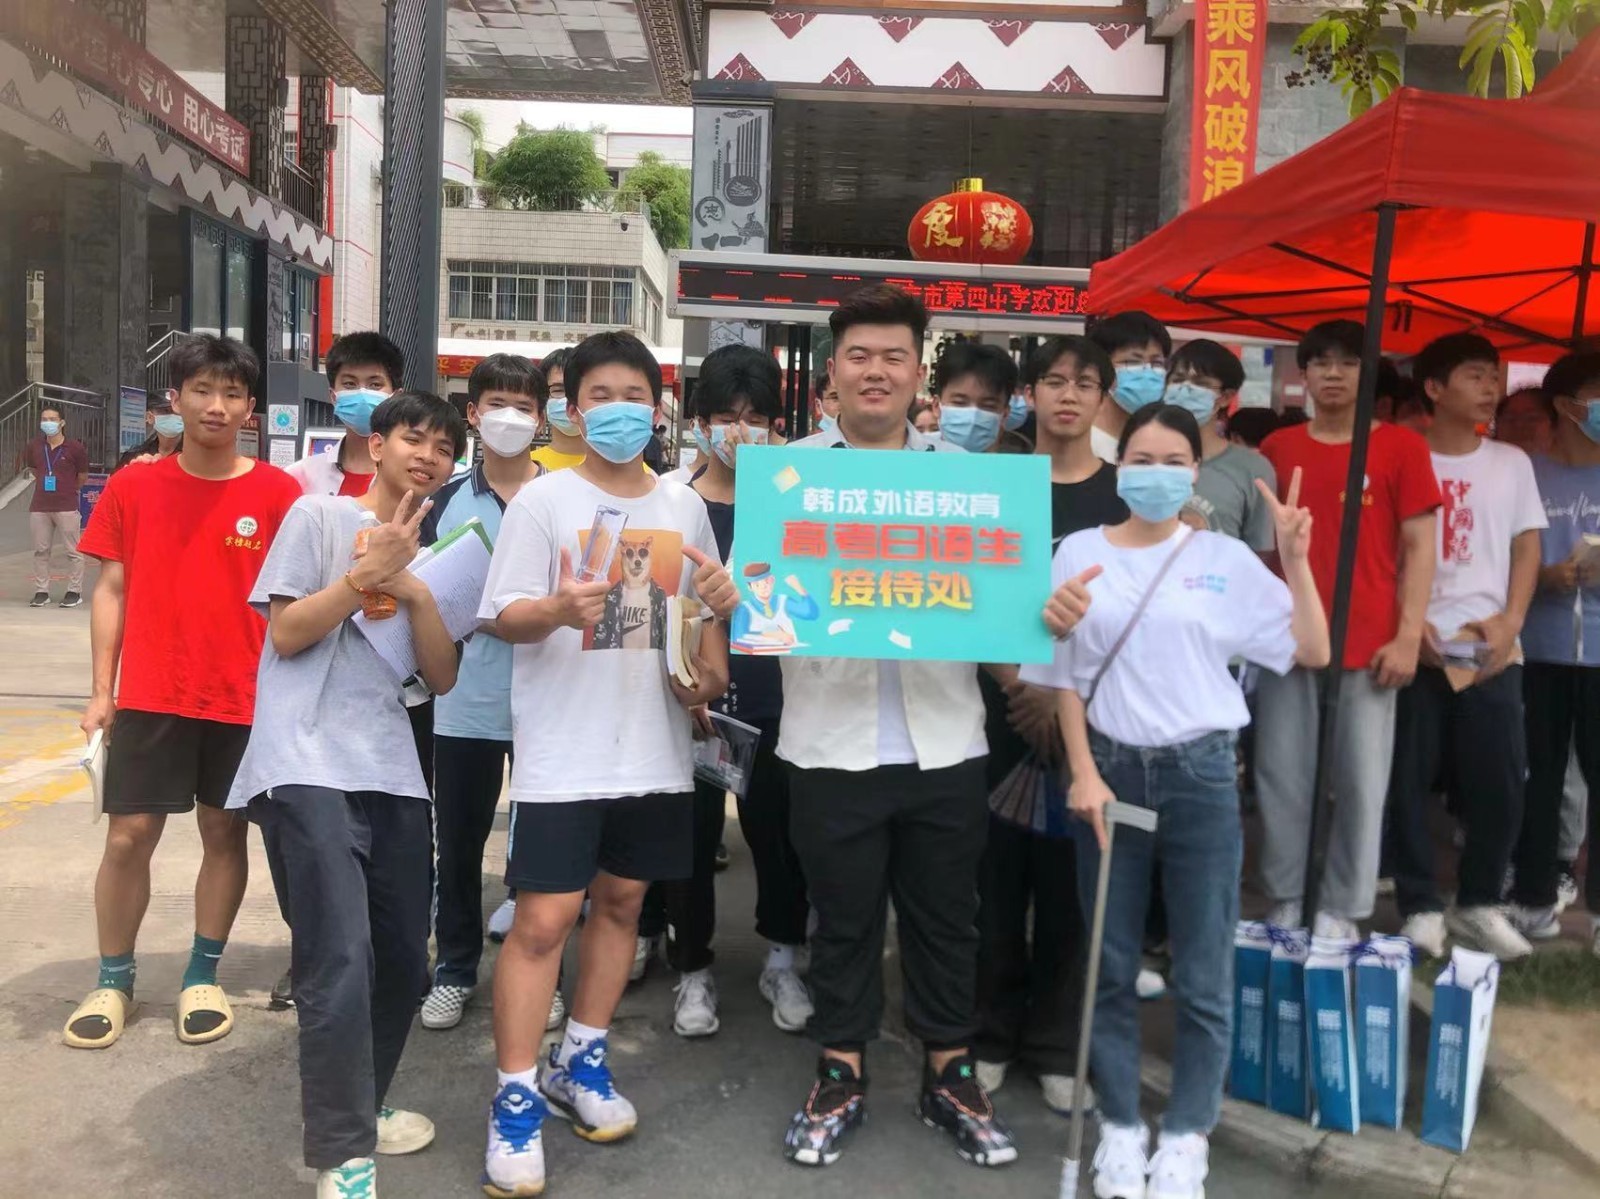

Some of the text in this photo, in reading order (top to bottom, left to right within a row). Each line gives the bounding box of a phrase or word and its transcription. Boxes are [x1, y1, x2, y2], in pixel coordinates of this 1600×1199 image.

[1203, 0, 1256, 202] 乘风破浪
[183, 92, 246, 164] 用心考试
[922, 201, 964, 248] 度
[803, 487, 1000, 519] 韩成外语教育
[782, 520, 1021, 565] 高考日语生
[830, 568, 973, 610] 接待处
